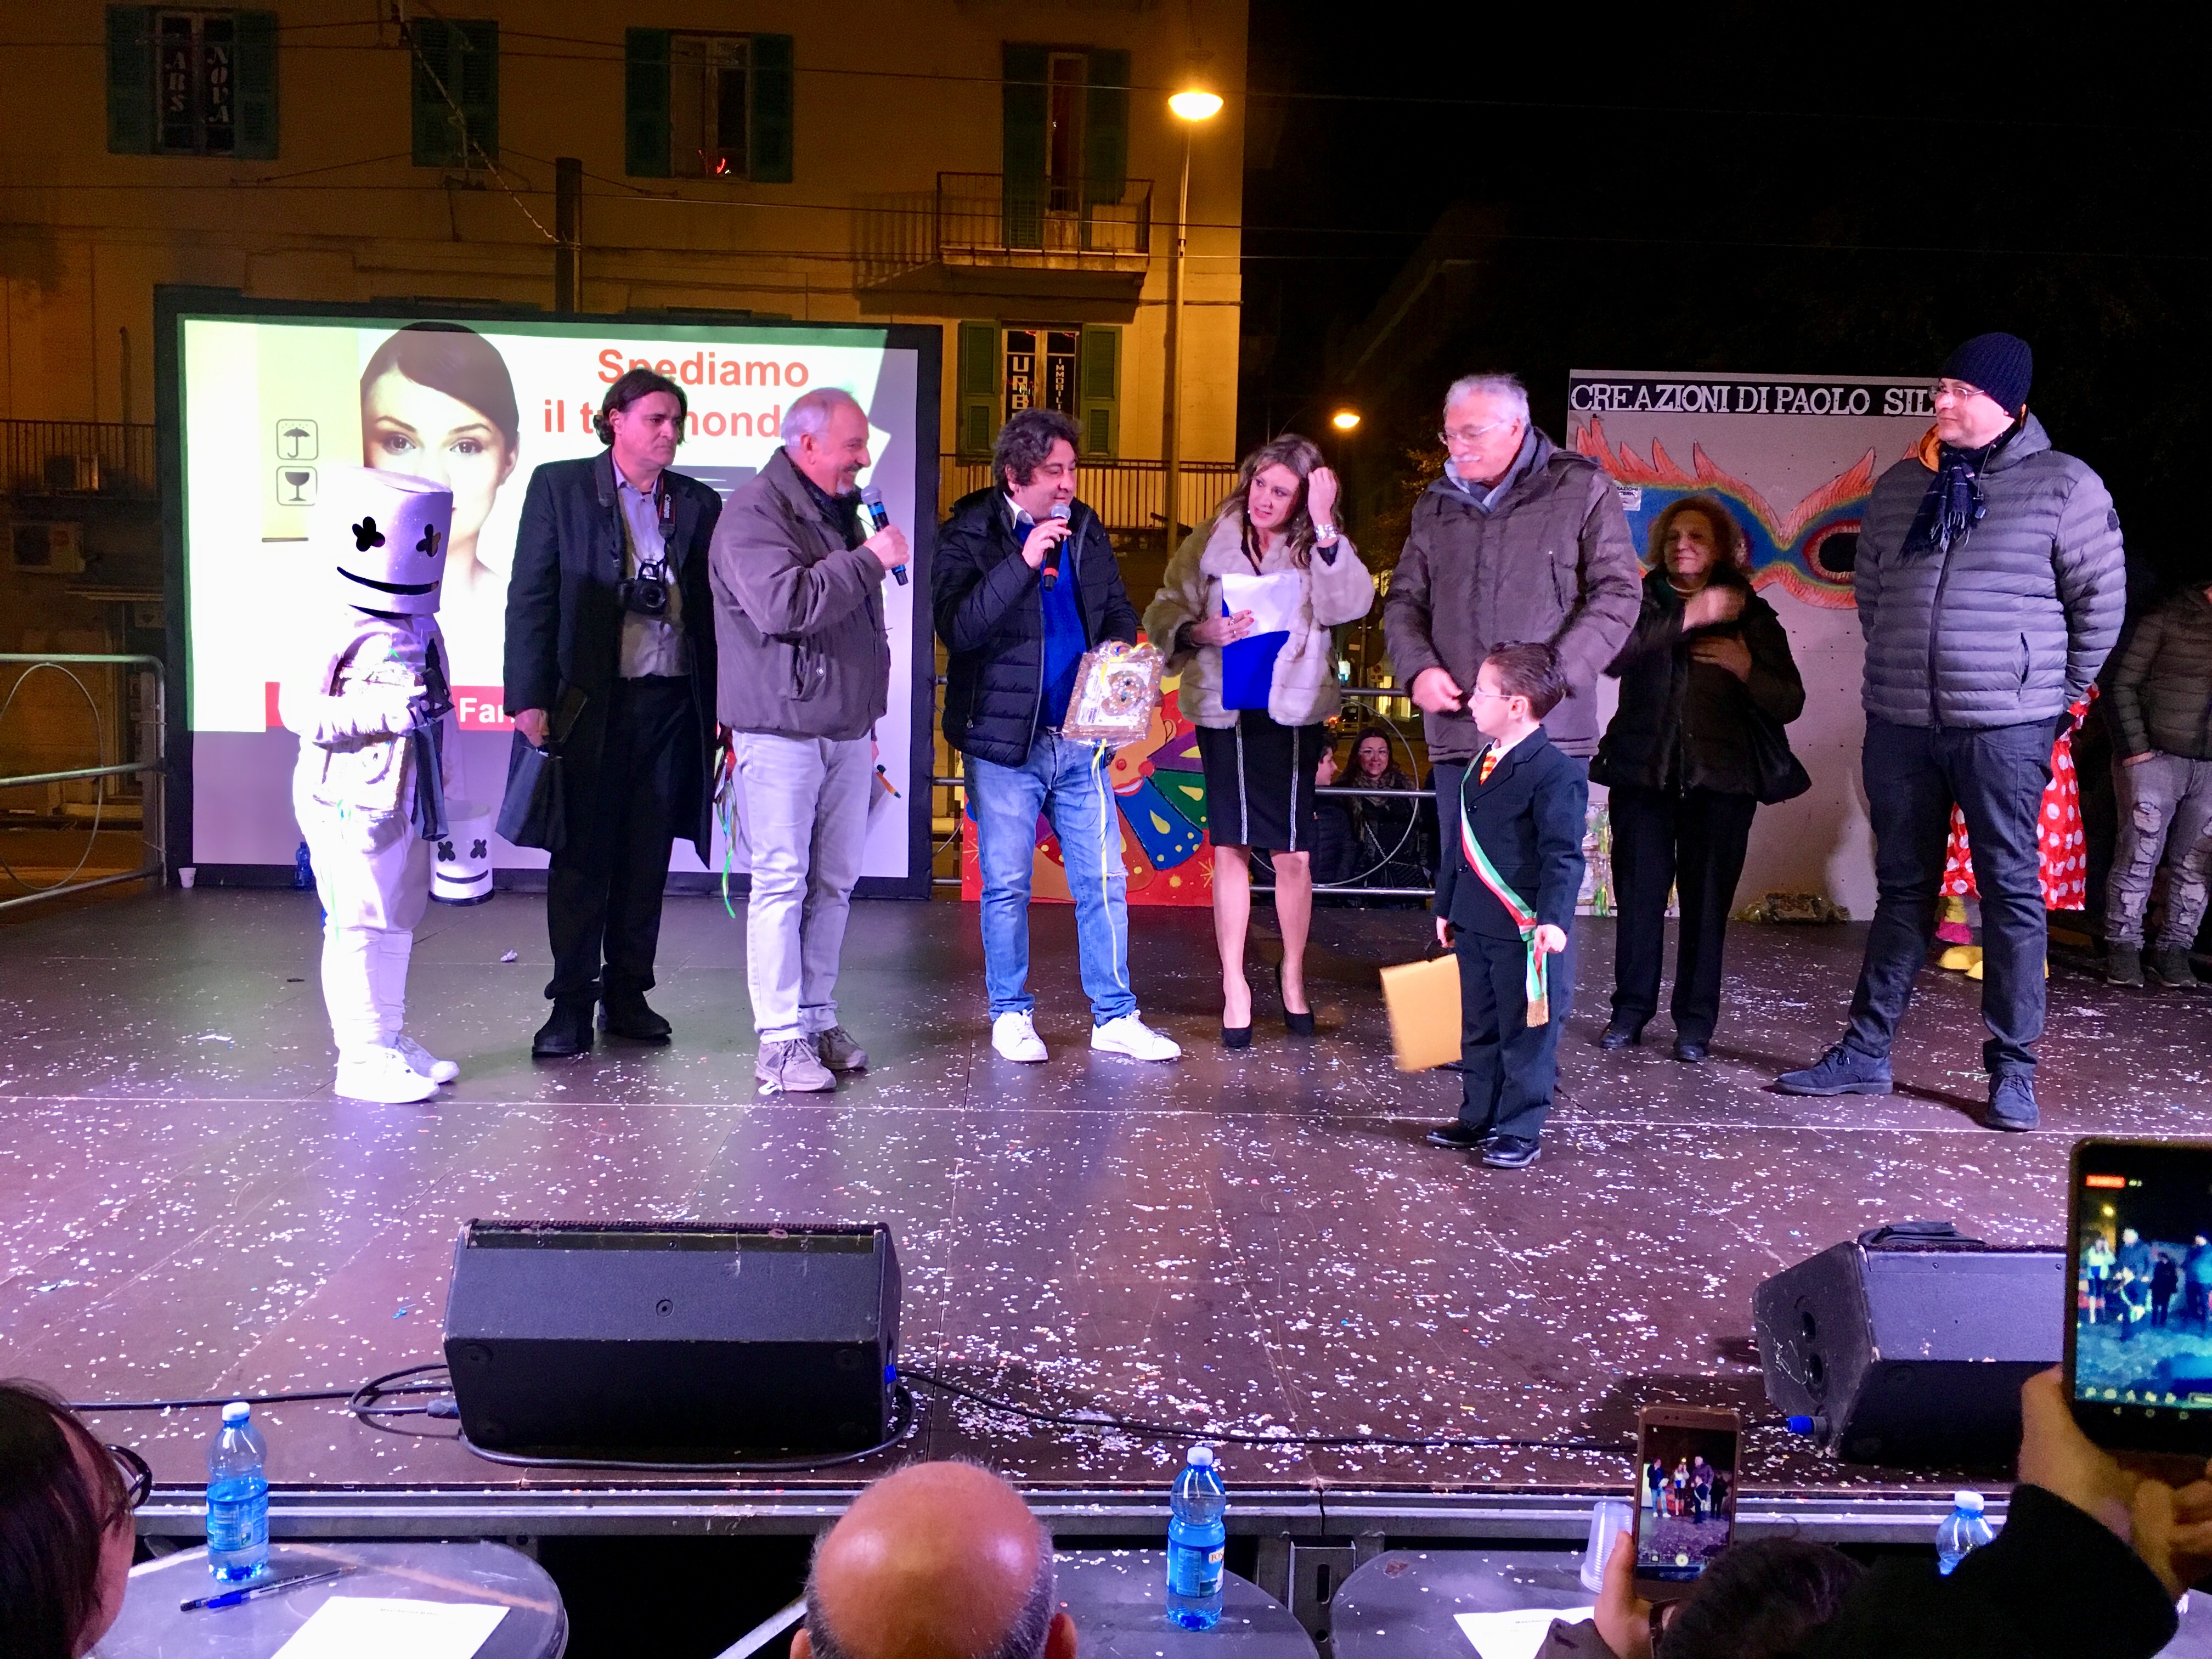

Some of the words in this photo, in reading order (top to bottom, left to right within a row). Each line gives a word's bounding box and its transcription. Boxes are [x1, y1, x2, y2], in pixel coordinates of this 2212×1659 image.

[1012, 357, 1030, 418] URB
[1056, 358, 1065, 414] IMMOBILI
[1571, 383, 1730, 413] CREAZIONI
[1735, 386, 1769, 413] DI
[1773, 386, 1870, 415] PAOLO
[1883, 388, 1937, 416] SIL
[545, 399, 564, 432] il
[686, 404, 781, 437] ond
